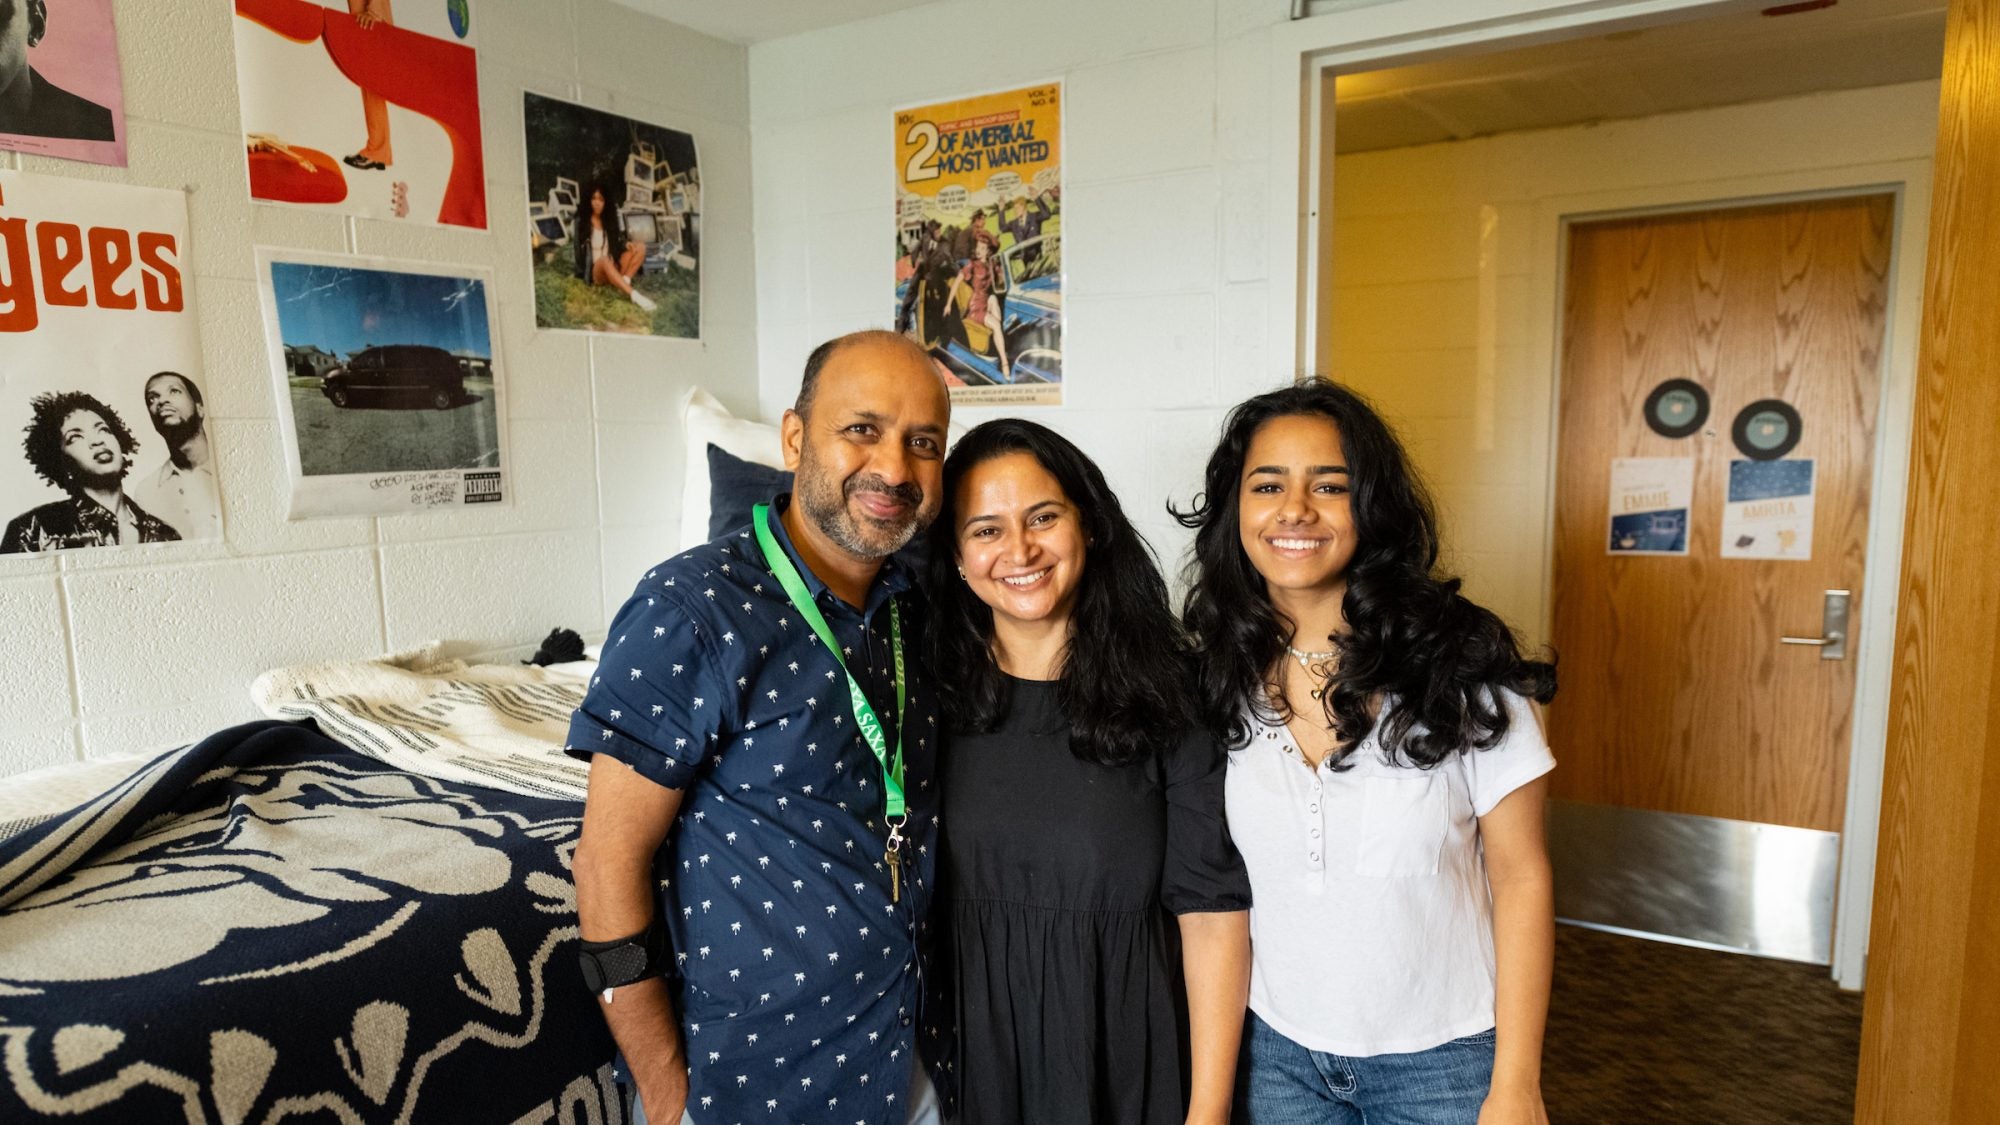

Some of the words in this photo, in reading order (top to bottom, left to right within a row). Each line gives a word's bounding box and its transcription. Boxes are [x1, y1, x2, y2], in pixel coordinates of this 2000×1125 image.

[905, 120, 941, 184] 2
[938, 132, 959, 154] OF
[961, 119, 1035, 151] AMERIKAZ
[938, 150, 983, 175] MOST
[986, 140, 1049, 169] WANTED
[466, 479, 500, 493] ADVISORY
[1623, 491, 1670, 512] EMMIE
[1743, 500, 1797, 519] AMRITA
[858, 712, 888, 762] SAXA
